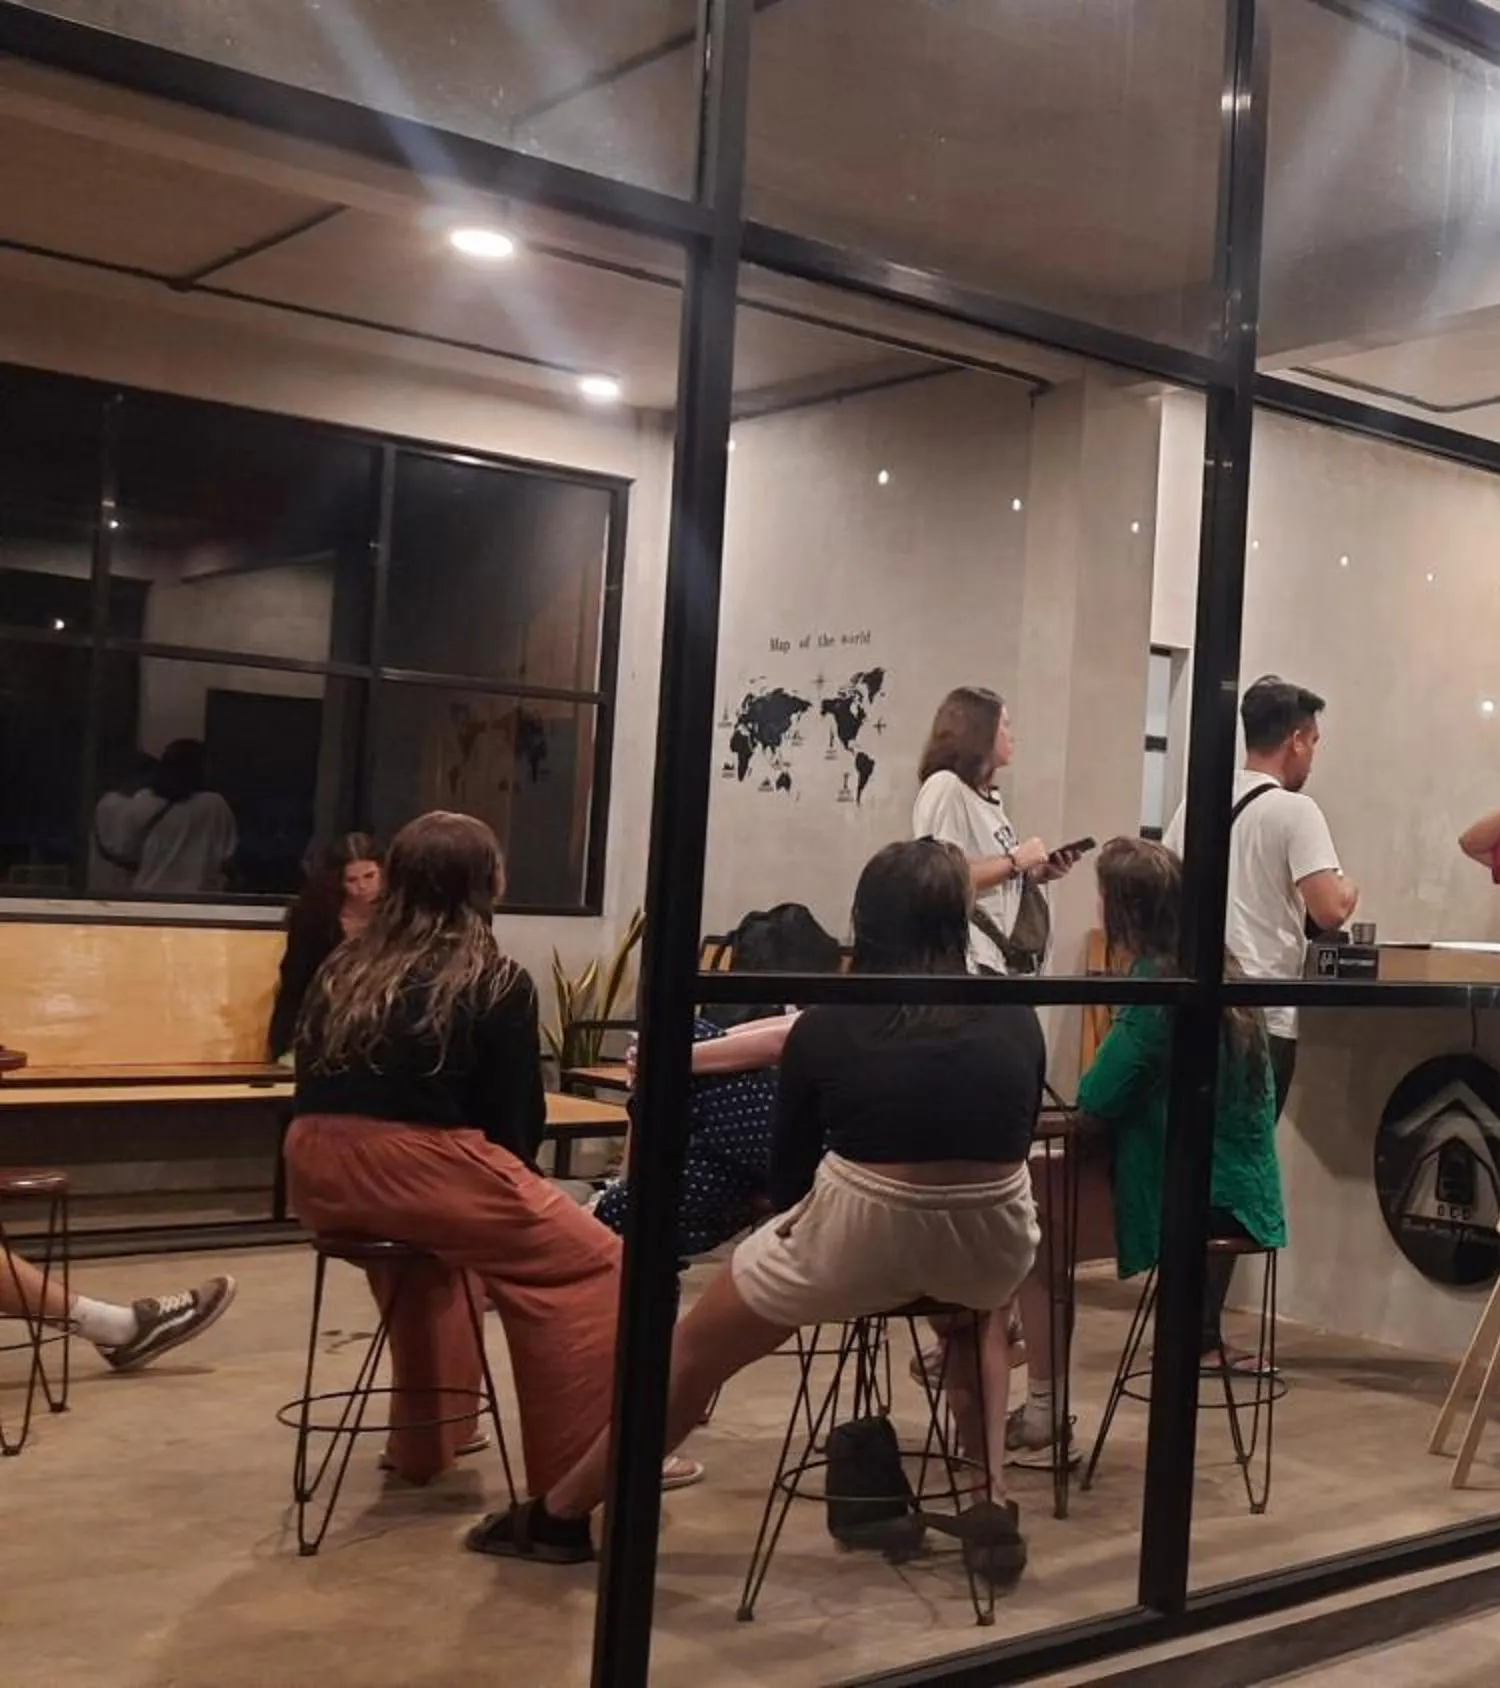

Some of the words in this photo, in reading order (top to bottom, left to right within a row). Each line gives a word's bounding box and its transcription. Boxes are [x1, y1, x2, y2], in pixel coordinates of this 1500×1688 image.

[769, 637, 791, 654] Map
[799, 634, 811, 649] of
[817, 632, 835, 648] the
[841, 630, 872, 645] world
